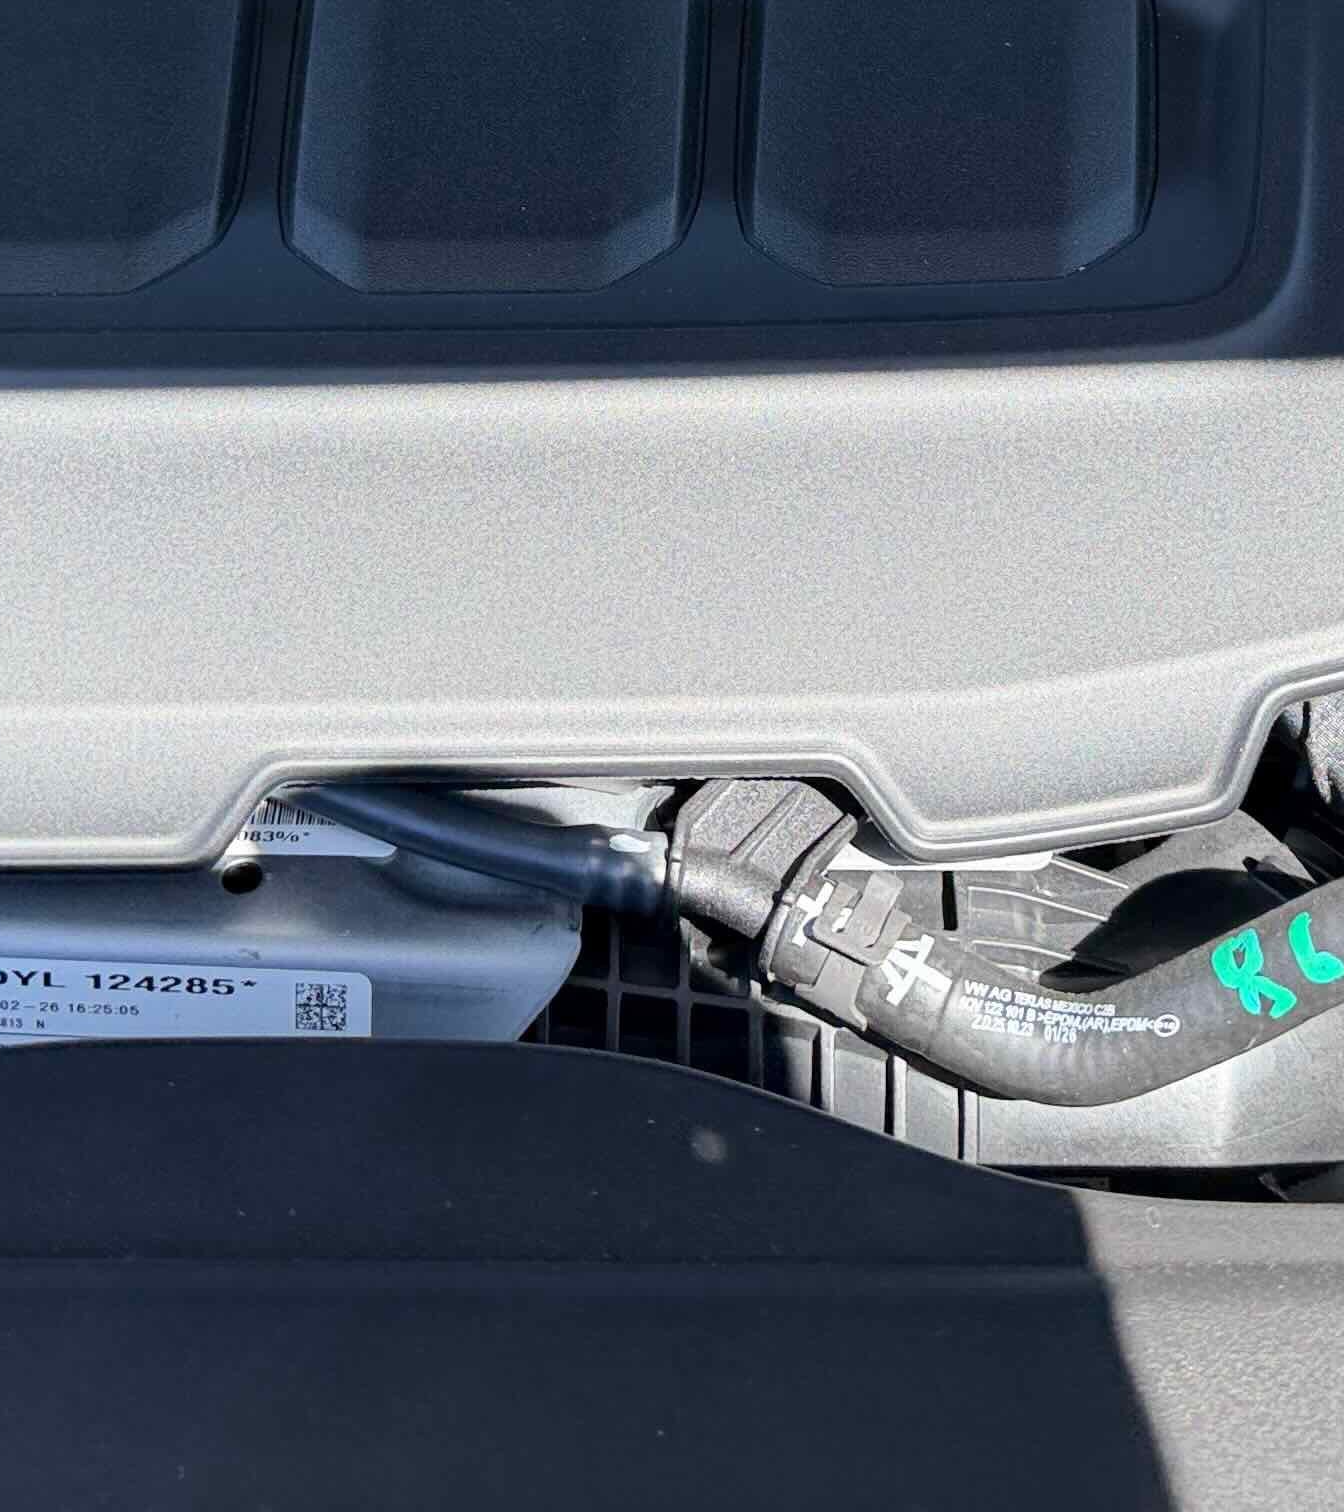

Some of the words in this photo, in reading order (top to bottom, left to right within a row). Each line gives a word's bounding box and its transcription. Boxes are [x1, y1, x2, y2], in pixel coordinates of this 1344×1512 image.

[964, 980, 988, 999] VW
[989, 985, 1012, 1002] AG
[68, 1002, 140, 1016] 16:25:05
